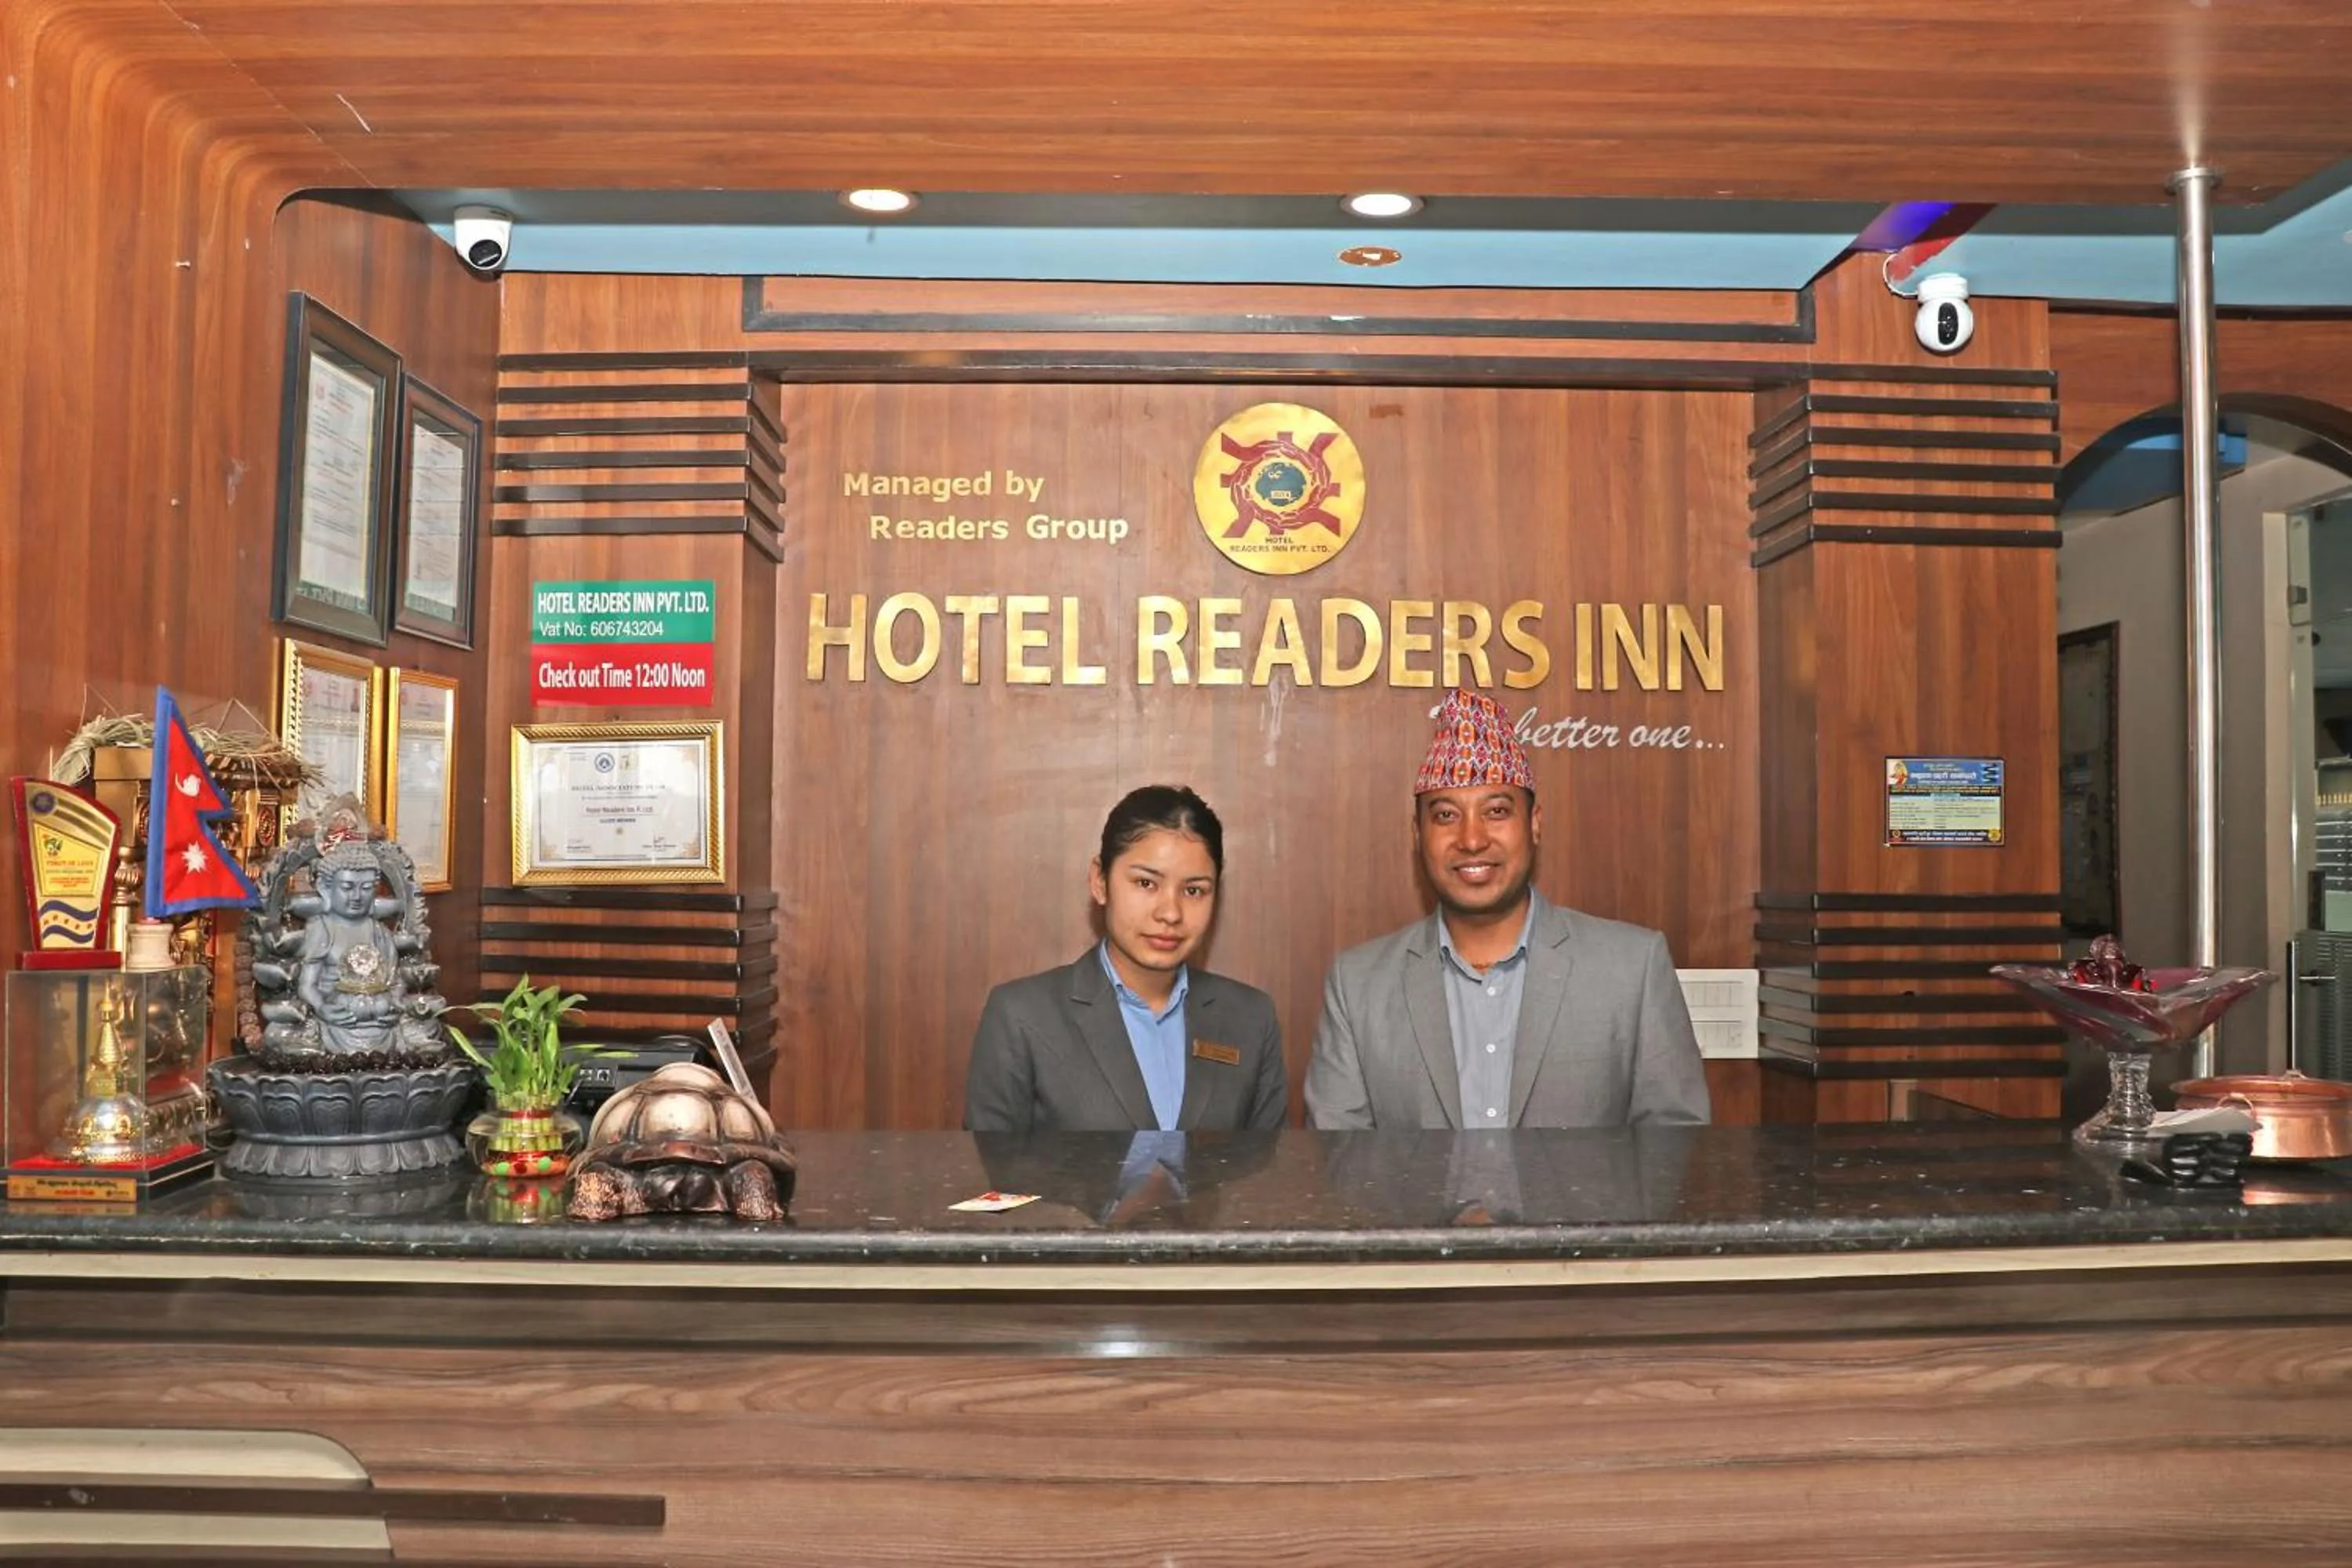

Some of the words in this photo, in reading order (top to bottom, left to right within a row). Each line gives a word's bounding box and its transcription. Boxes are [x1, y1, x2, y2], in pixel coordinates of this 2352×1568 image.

[843, 470, 993, 503] Managed
[1005, 470, 1044, 503] by
[869, 514, 1010, 540] Readers
[1025, 514, 1129, 544] Group
[538, 592, 576, 614] HOTEL
[578, 592, 631, 614] READERS
[633, 592, 655, 613] INN
[657, 591, 683, 613] PVT.
[684, 591, 710, 612] LTD.
[539, 621, 561, 637] Vat
[564, 621, 587, 637] No:
[590, 620, 664, 637] 606743204
[806, 592, 1106, 685] HOTEL
[1137, 595, 1551, 690] READERS
[1574, 602, 1724, 691] INN
[539, 662, 576, 688] Check
[579, 666, 600, 688] out
[601, 662, 633, 688] Time
[636, 663, 669, 688] 12:00
[671, 663, 705, 688] Noon
[1514, 706, 1621, 749] better
